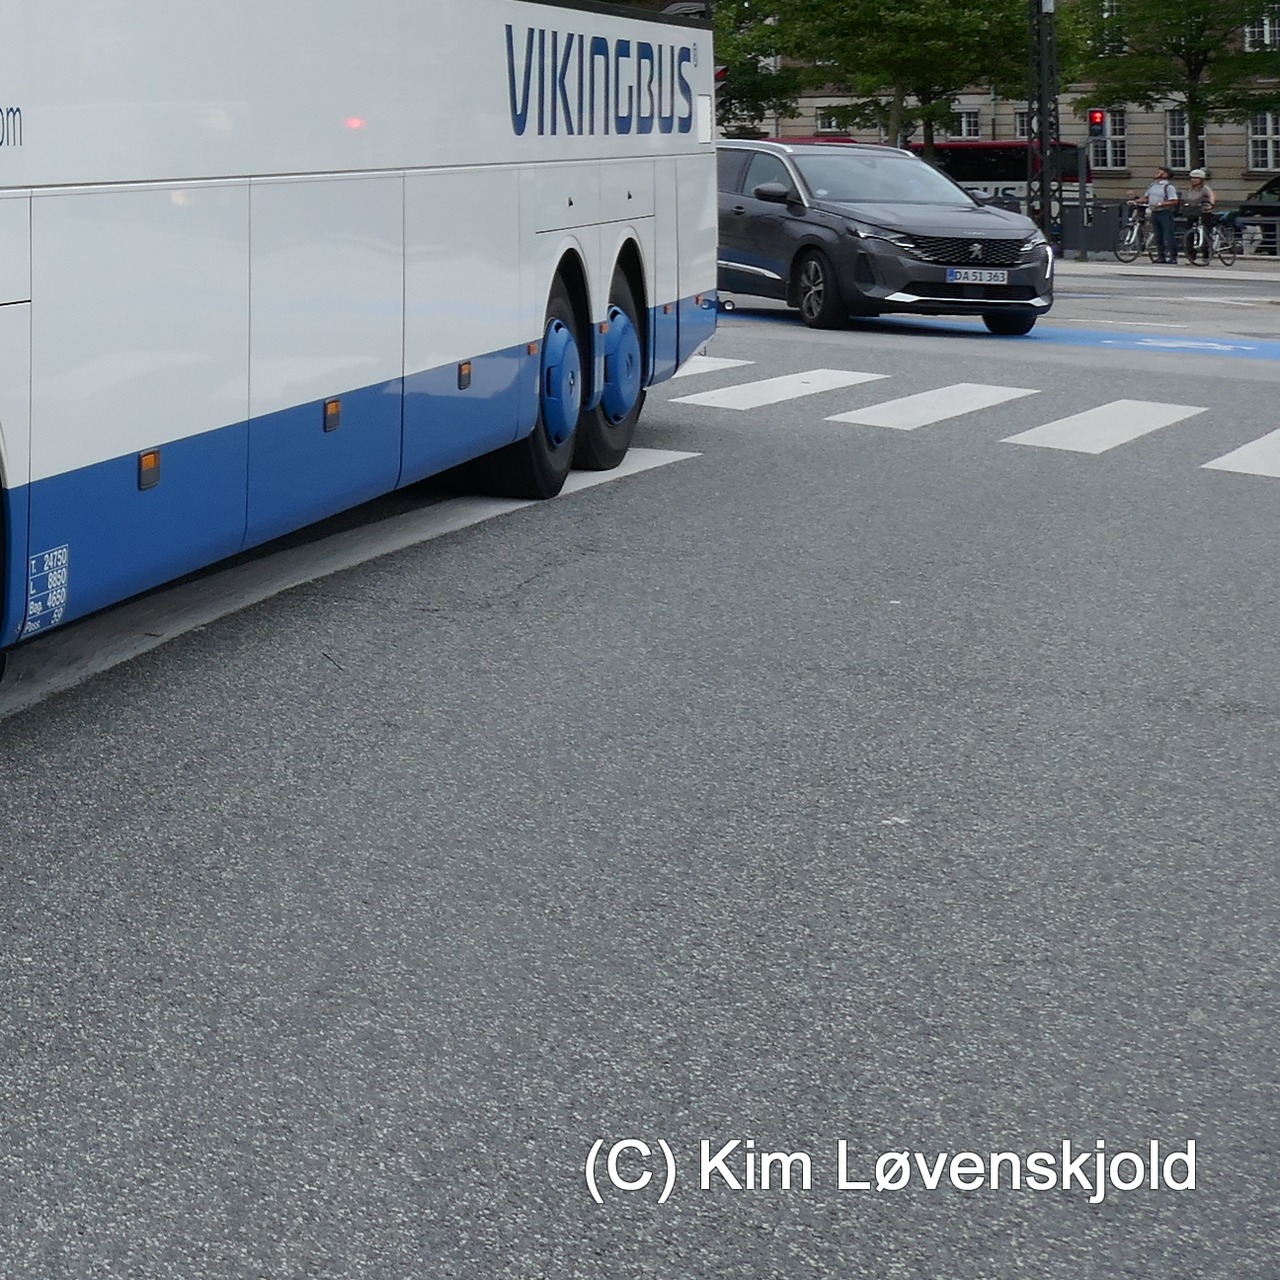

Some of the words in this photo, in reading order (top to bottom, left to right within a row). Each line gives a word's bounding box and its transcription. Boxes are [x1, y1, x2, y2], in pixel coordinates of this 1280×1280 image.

[955, 271, 969, 281] DA
[972, 271, 983, 282] 51
[987, 272, 1005, 282] 363
[44, 547, 67, 571] 24750
[47, 567, 67, 589] 8850
[46, 587, 66, 608] 4650
